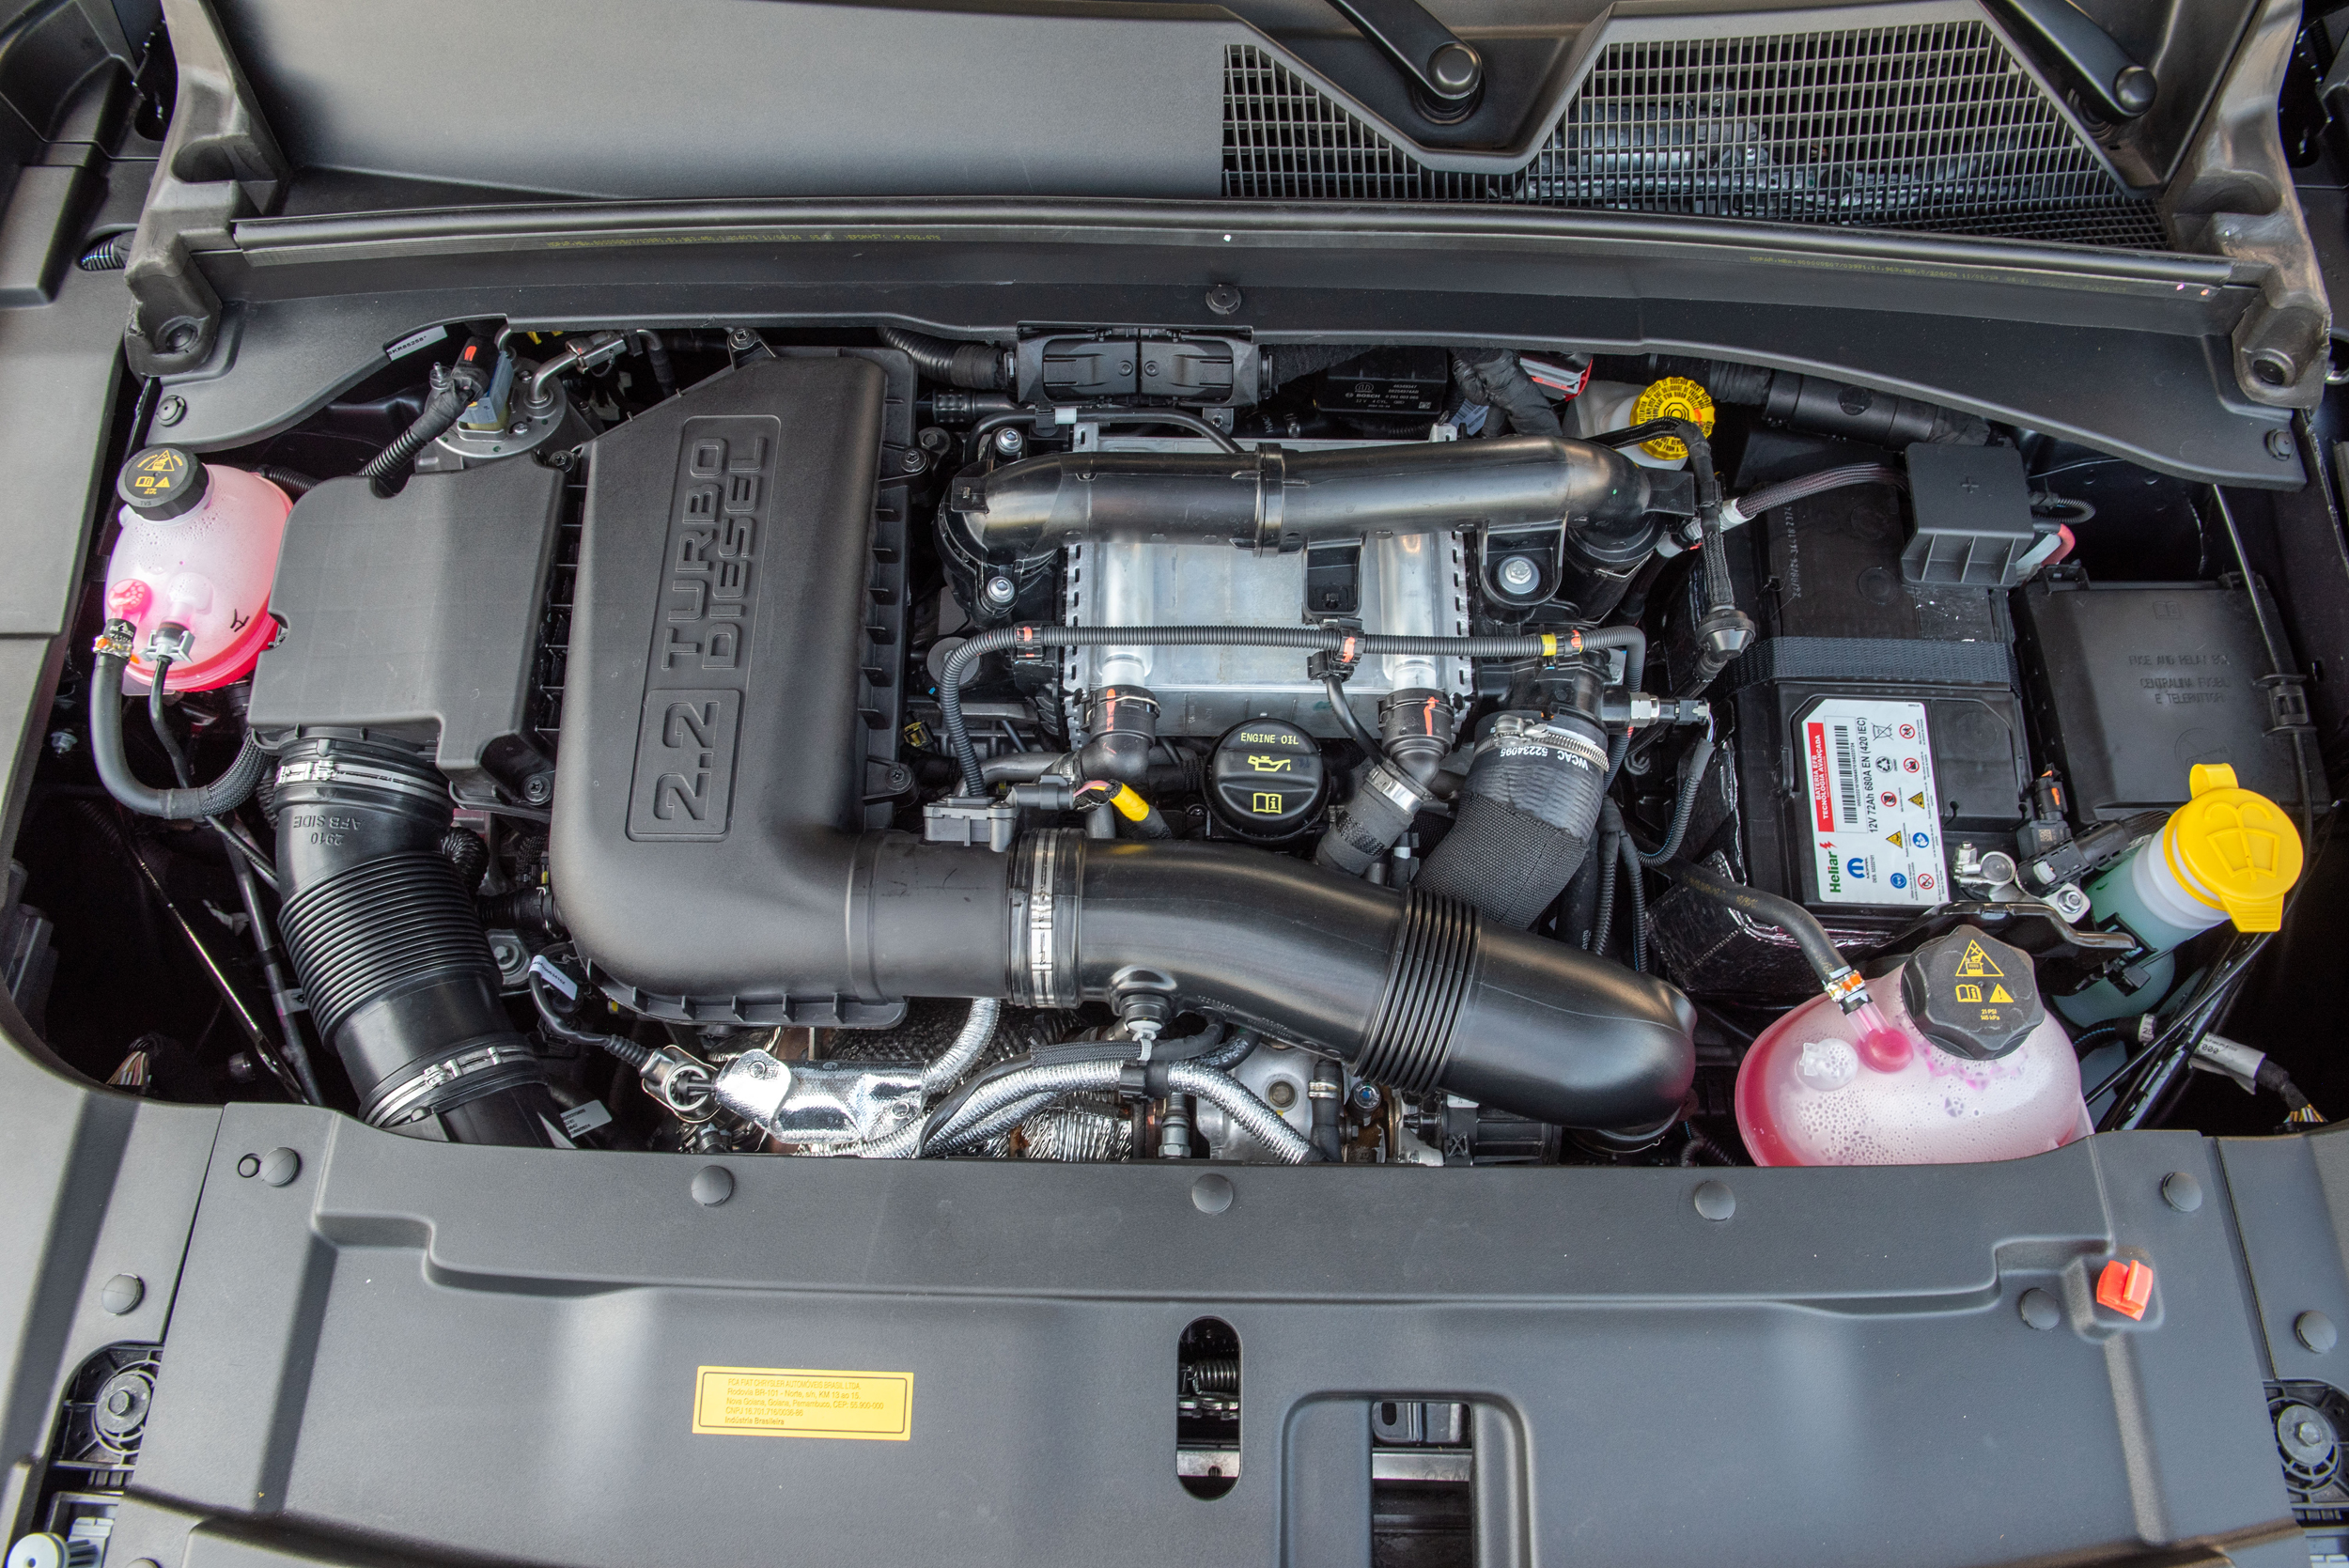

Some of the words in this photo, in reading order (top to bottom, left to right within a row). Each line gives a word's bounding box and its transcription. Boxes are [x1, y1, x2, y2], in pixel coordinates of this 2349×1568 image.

[661, 437, 727, 670] TURBO
[702, 436, 768, 670] DIESEL
[2156, 655, 2175, 666] AND
[2155, 693, 2163, 705] E
[1857, 717, 1867, 735] IEC)
[1240, 732, 1276, 743] ENGINE
[1281, 735, 1299, 745] OIL
[1859, 737, 1871, 755] (420
[653, 701, 721, 821] 2.2
[1500, 745, 1549, 757] 52234095
[1557, 750, 1589, 770] WCAC
[1815, 735, 1825, 772] AVANÇADA
[1861, 756, 1871, 770] EN
[1863, 770, 1874, 791] 680A
[1819, 772, 1829, 820] TECNOLOGIA
[1865, 793, 1876, 815] 72Ah
[293, 815, 326, 829] SIDE
[329, 816, 365, 831] AFB
[1869, 816, 1878, 833] 12V
[310, 832, 345, 846] 2910
[1828, 851, 1842, 893] Heliar
[740, 1378, 753, 1387] FIAT
[754, 1379, 785, 1388] CHRYSLER
[785, 1379, 823, 1389] AUTOMÓVEIS
[727, 1388, 753, 1396] Rodovia
[784, 1389, 804, 1398] Norte,
[805, 1390, 817, 1399] s/n,
[818, 1390, 831, 1399] KM
[832, 1390, 839, 1399] 13
[850, 1391, 861, 1400] 15.
[743, 1398, 766, 1406] Goiana,
[768, 1399, 790, 1407] Goiana,
[792, 1400, 832, 1408] Pernambuco,
[724, 1416, 753, 1424] Indústria
[754, 1417, 785, 1425] Brasileira
